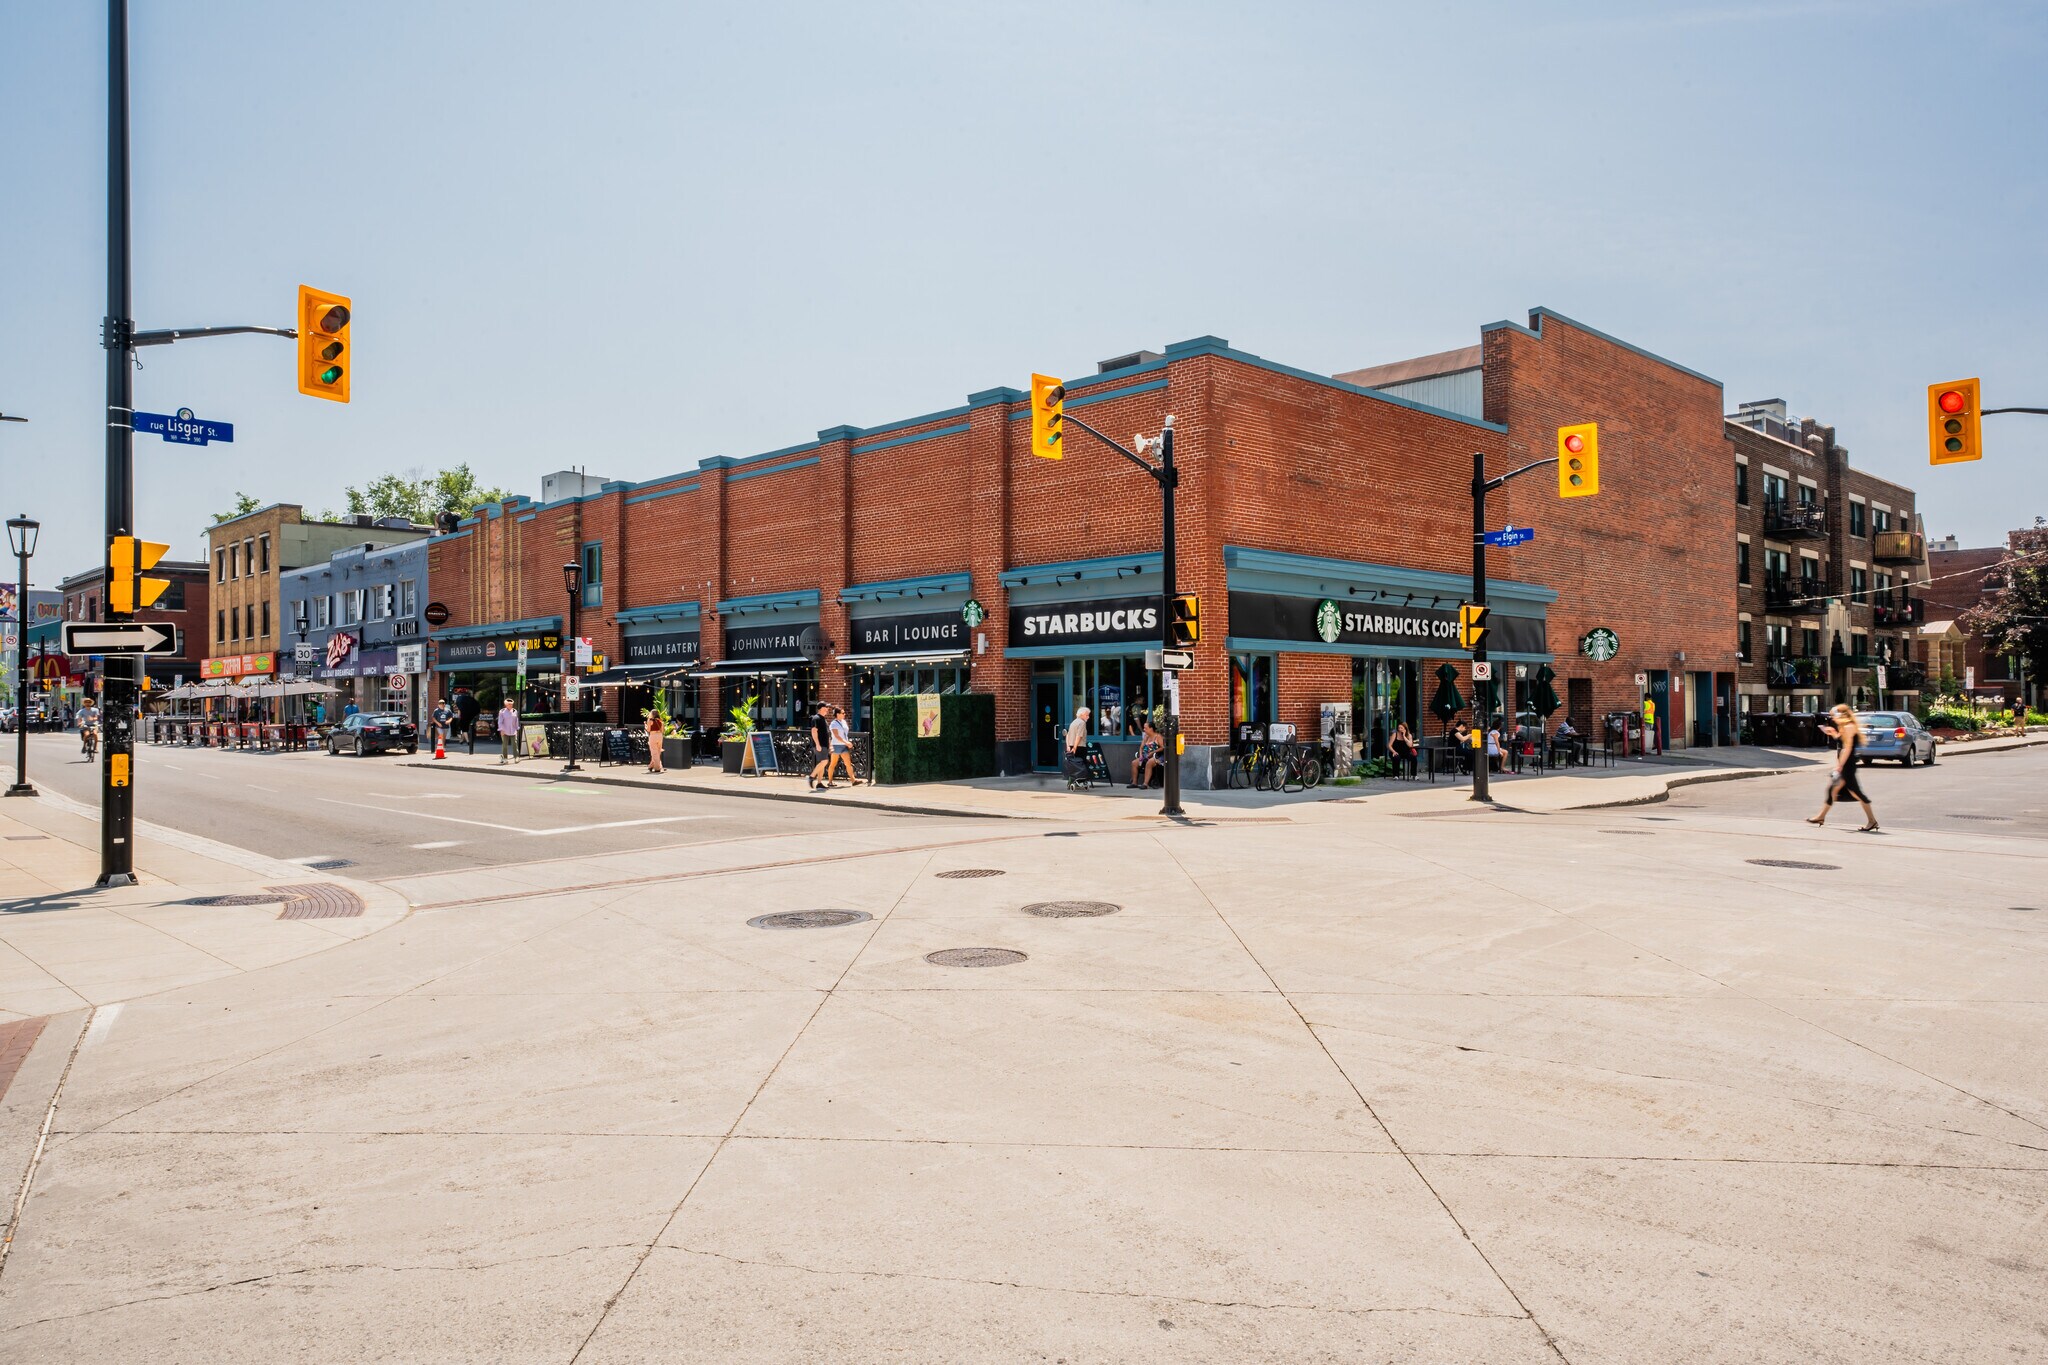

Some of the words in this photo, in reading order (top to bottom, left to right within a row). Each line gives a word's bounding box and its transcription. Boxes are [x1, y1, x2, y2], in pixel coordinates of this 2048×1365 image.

[150, 422, 164, 430] rue
[168, 419, 204, 437] Lisgar
[207, 427, 218, 437] St.
[1502, 531, 1519, 542] Elgin
[1024, 608, 1157, 636] STARBUCKS
[1345, 612, 1430, 637] STARBUCKS
[1431, 620, 1462, 639] COFF
[865, 629, 889, 643] BAR
[904, 624, 958, 640] LOUNGE
[450, 645, 482, 656] HARVEY'S
[630, 644, 663, 656] ITALIAN
[666, 641, 698, 654] EATERY
[732, 635, 800, 651] JOHNNYFARI
[298, 650, 310, 659] 30
[362, 666, 377, 675] LUNCH
[384, 664, 398, 674] DINNE
